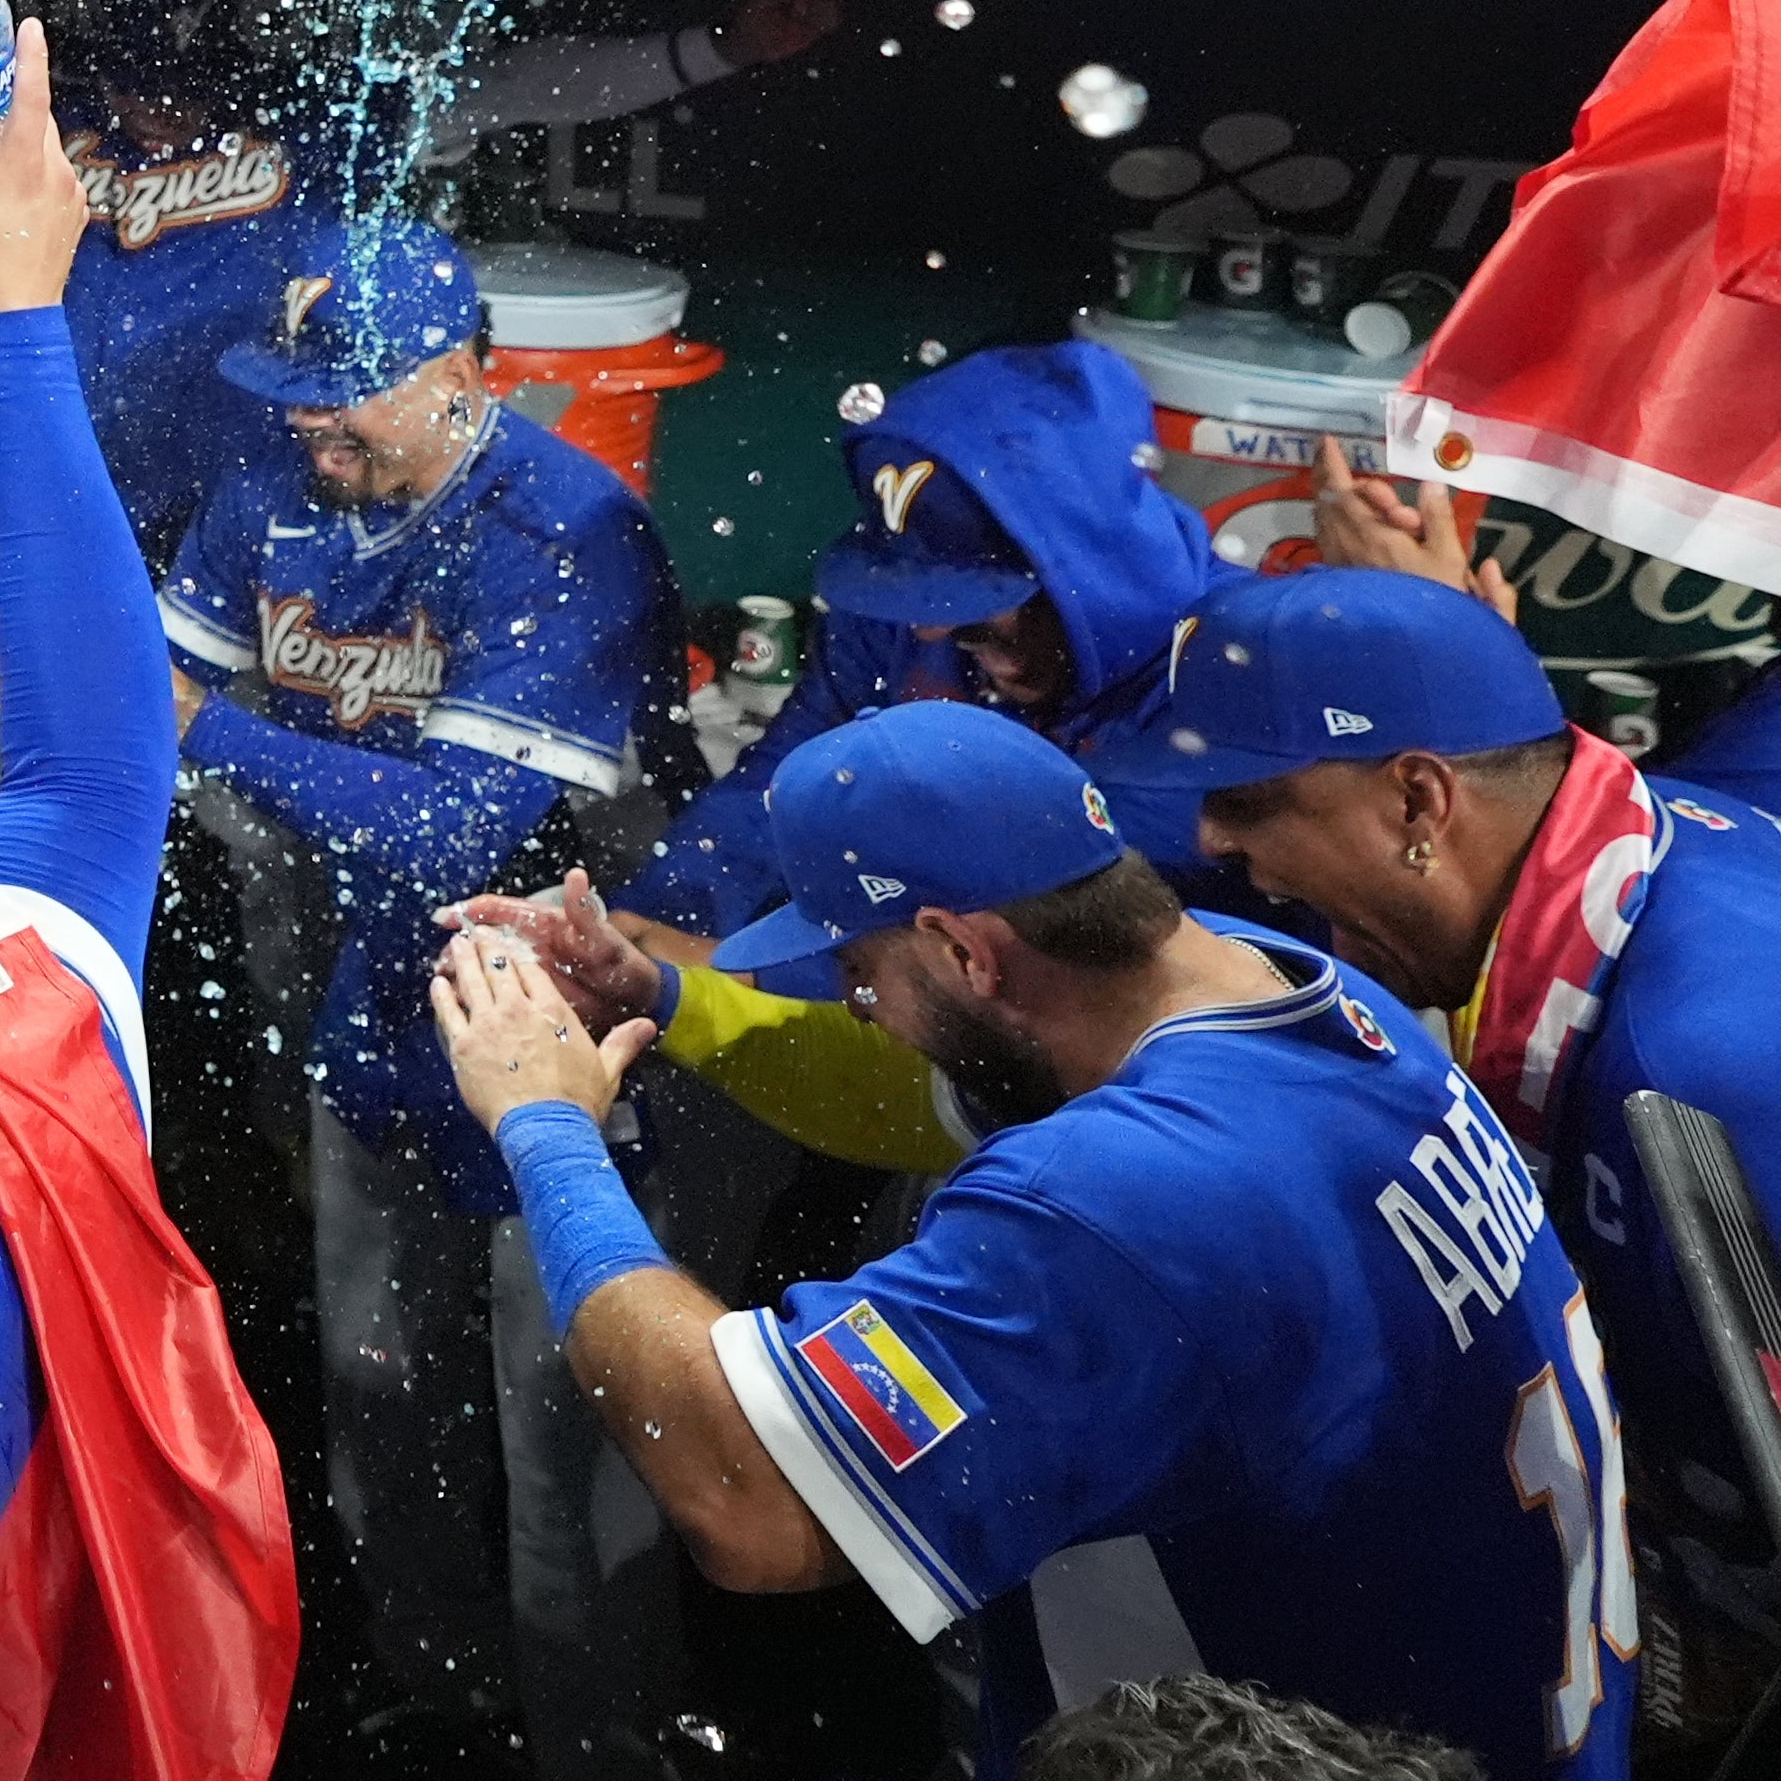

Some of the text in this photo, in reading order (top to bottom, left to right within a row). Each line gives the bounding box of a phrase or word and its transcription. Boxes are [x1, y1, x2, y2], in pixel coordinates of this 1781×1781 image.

[1226, 428, 1379, 472] WATR
[872, 460, 935, 533] V
[1375, 1062, 1545, 1355] ABRE
